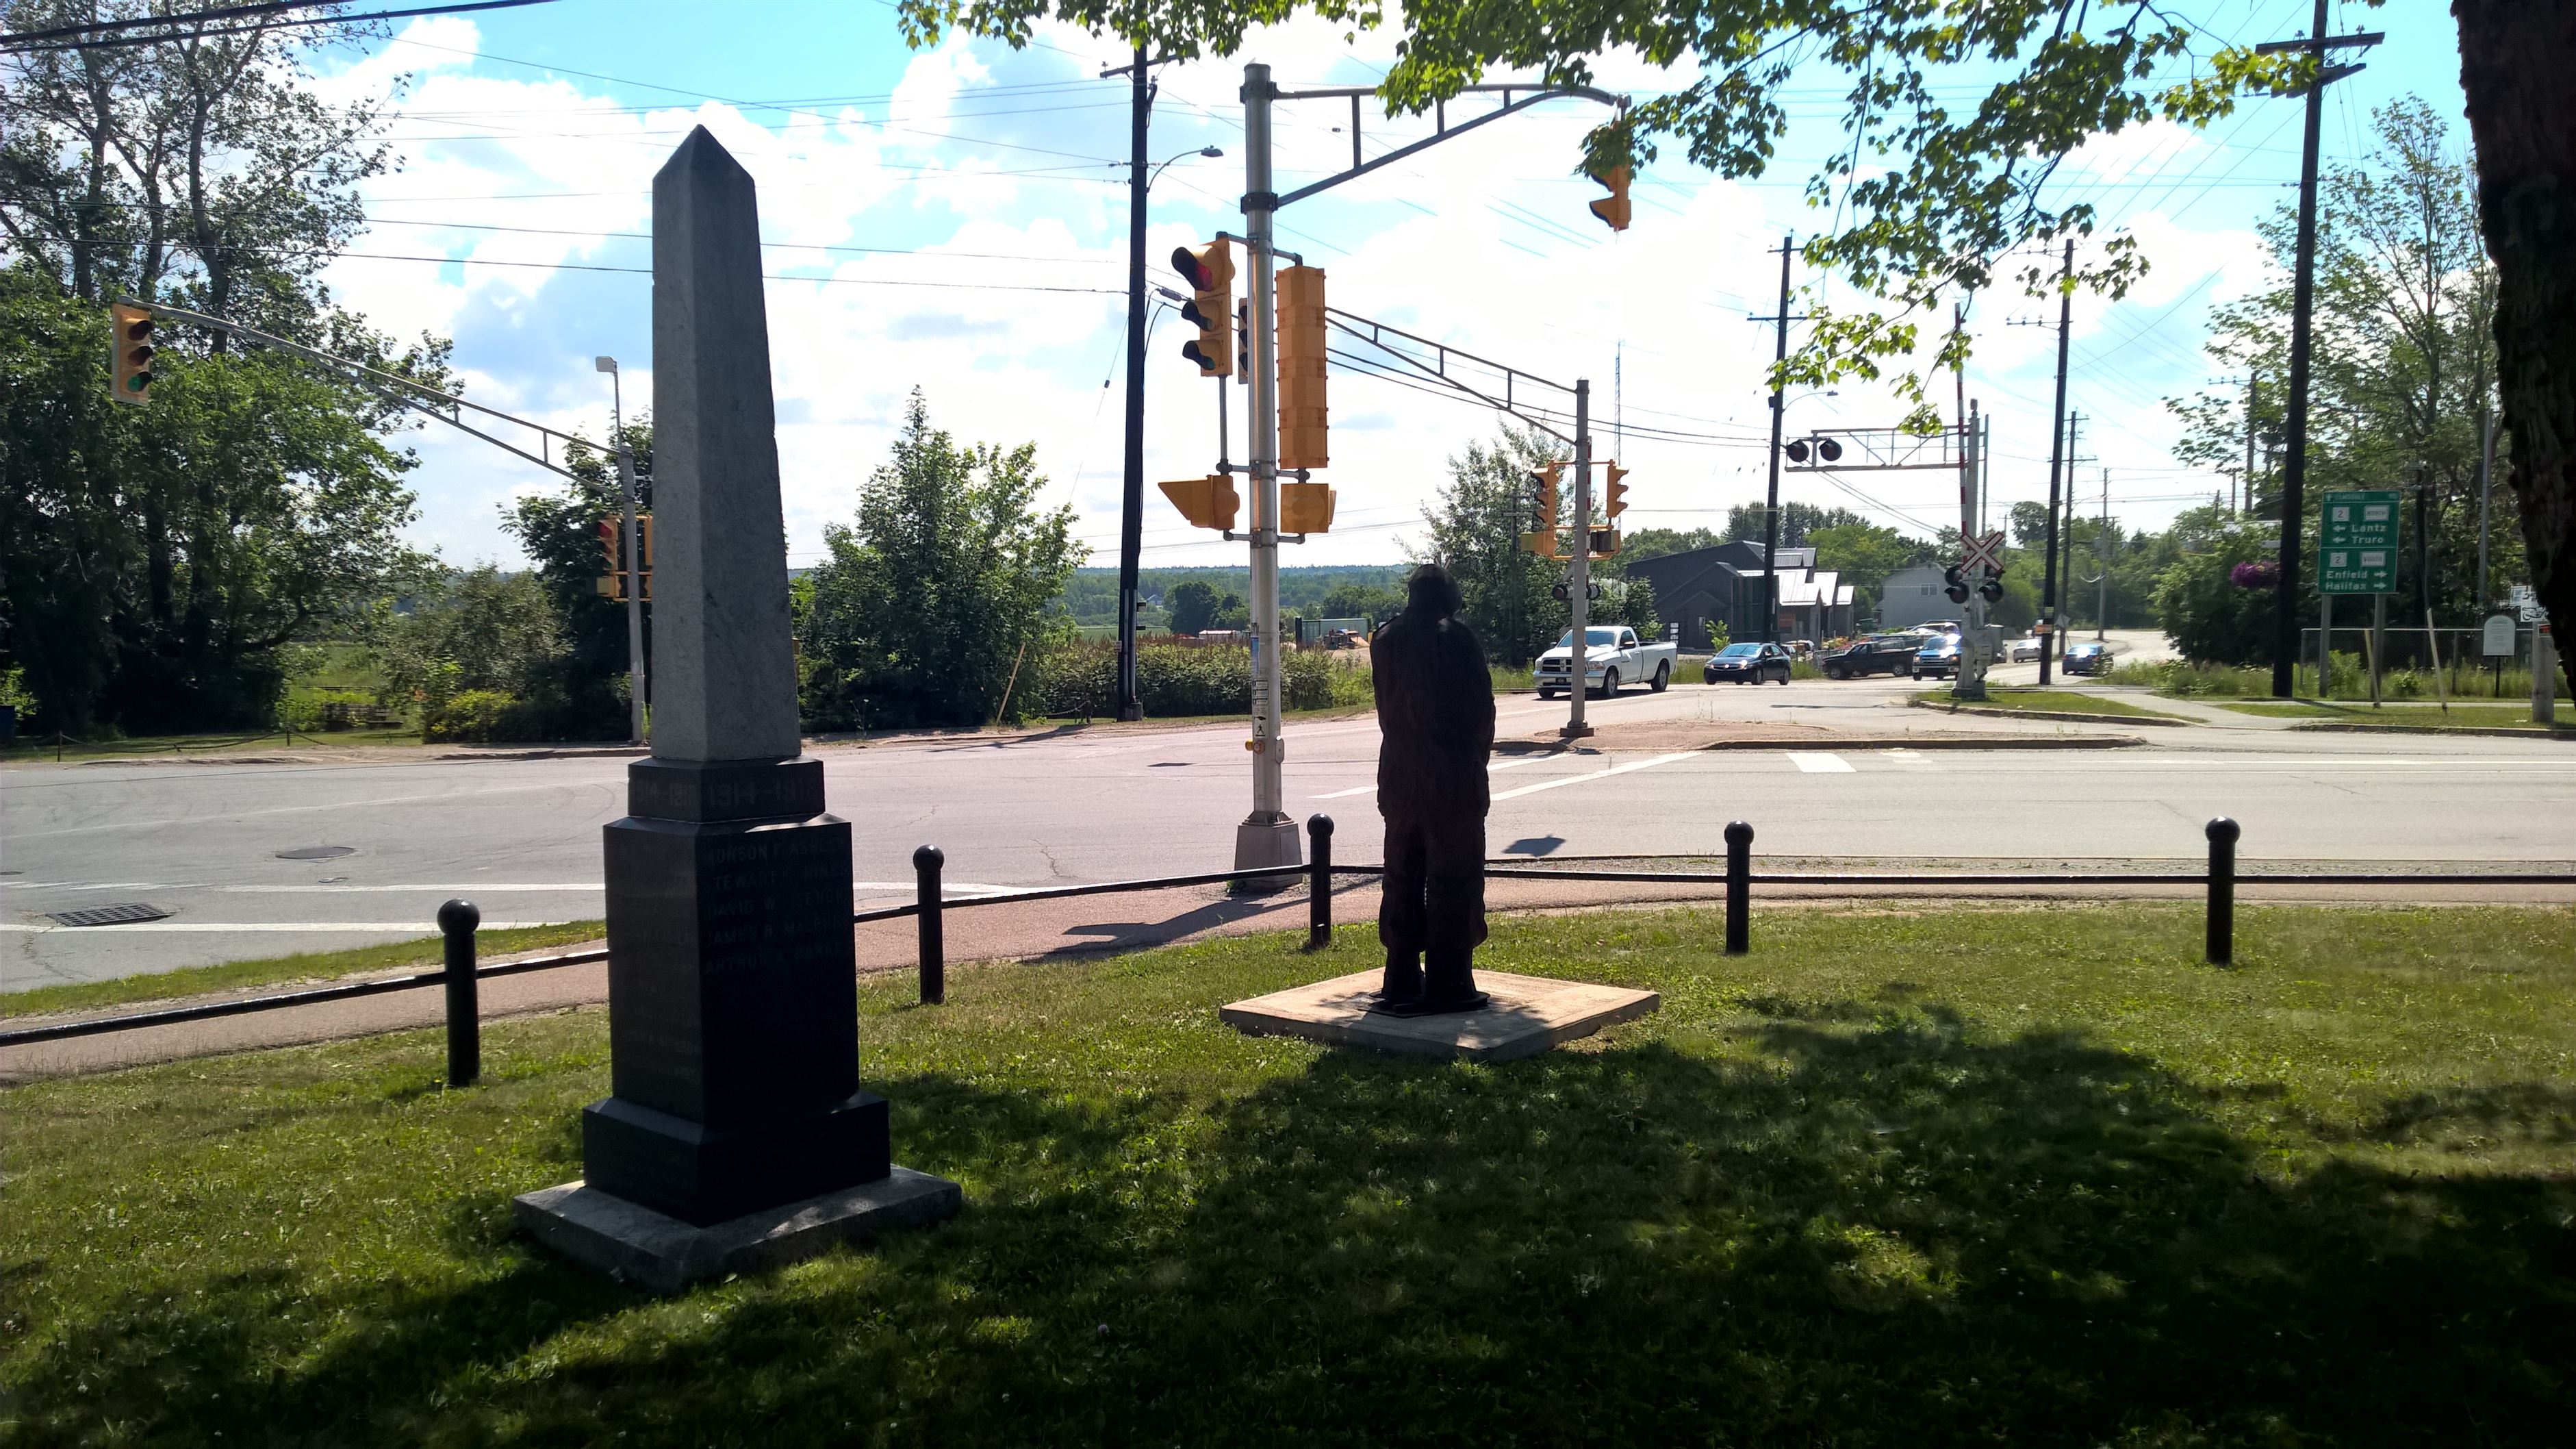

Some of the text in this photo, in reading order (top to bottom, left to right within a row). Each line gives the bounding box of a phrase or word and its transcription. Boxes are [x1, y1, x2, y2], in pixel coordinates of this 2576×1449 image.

[2338, 509, 2343, 518] 2
[2351, 525, 2387, 533] Lantz
[2351, 536, 2384, 544] Truro
[2326, 570, 2368, 579] Enfield
[2325, 582, 2367, 590] Halifax
[708, 899, 754, 918] DAVID
[763, 896, 775, 911] W
[706, 926, 758, 946] JAMES
[705, 953, 769, 974] ARTHUR
